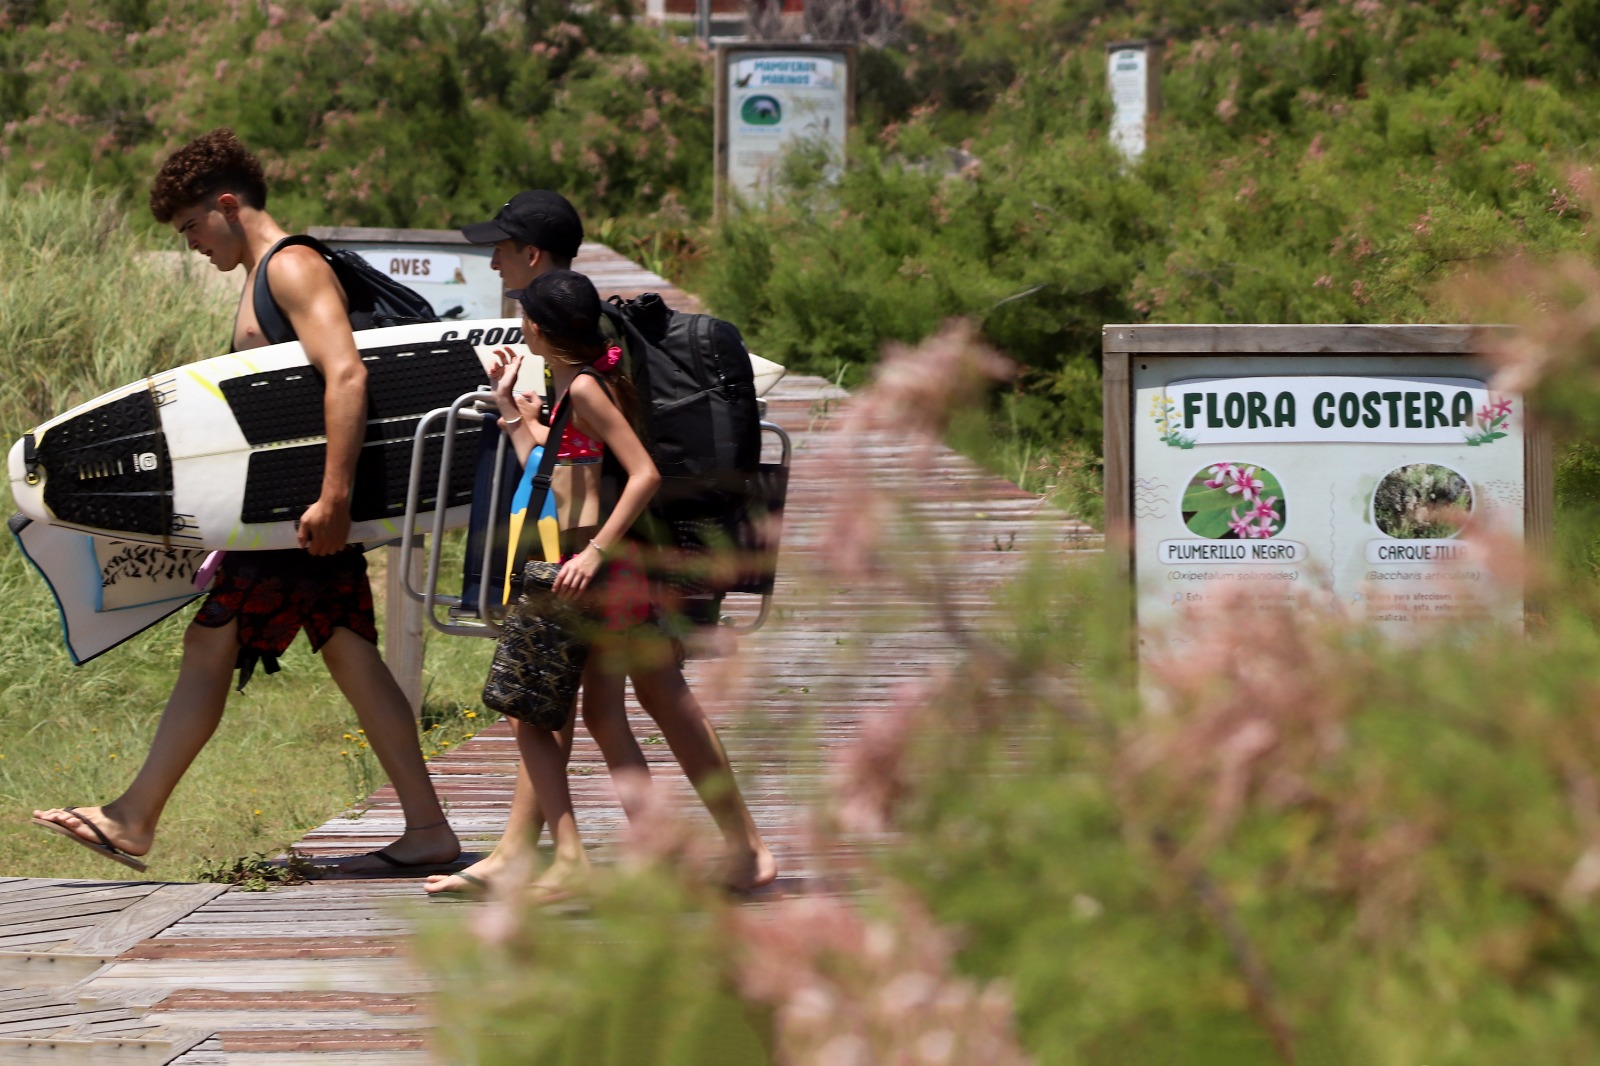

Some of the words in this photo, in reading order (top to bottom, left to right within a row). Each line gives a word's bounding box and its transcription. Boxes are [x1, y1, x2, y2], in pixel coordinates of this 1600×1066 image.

[390, 257, 431, 276] AVES
[1183, 391, 1296, 429] FLORA
[1312, 390, 1474, 428] COSTERA
[1168, 545, 1246, 559] PLUMERILLO
[1252, 545, 1296, 559] NEGRO
[1365, 571, 1422, 580] (Baccharis
